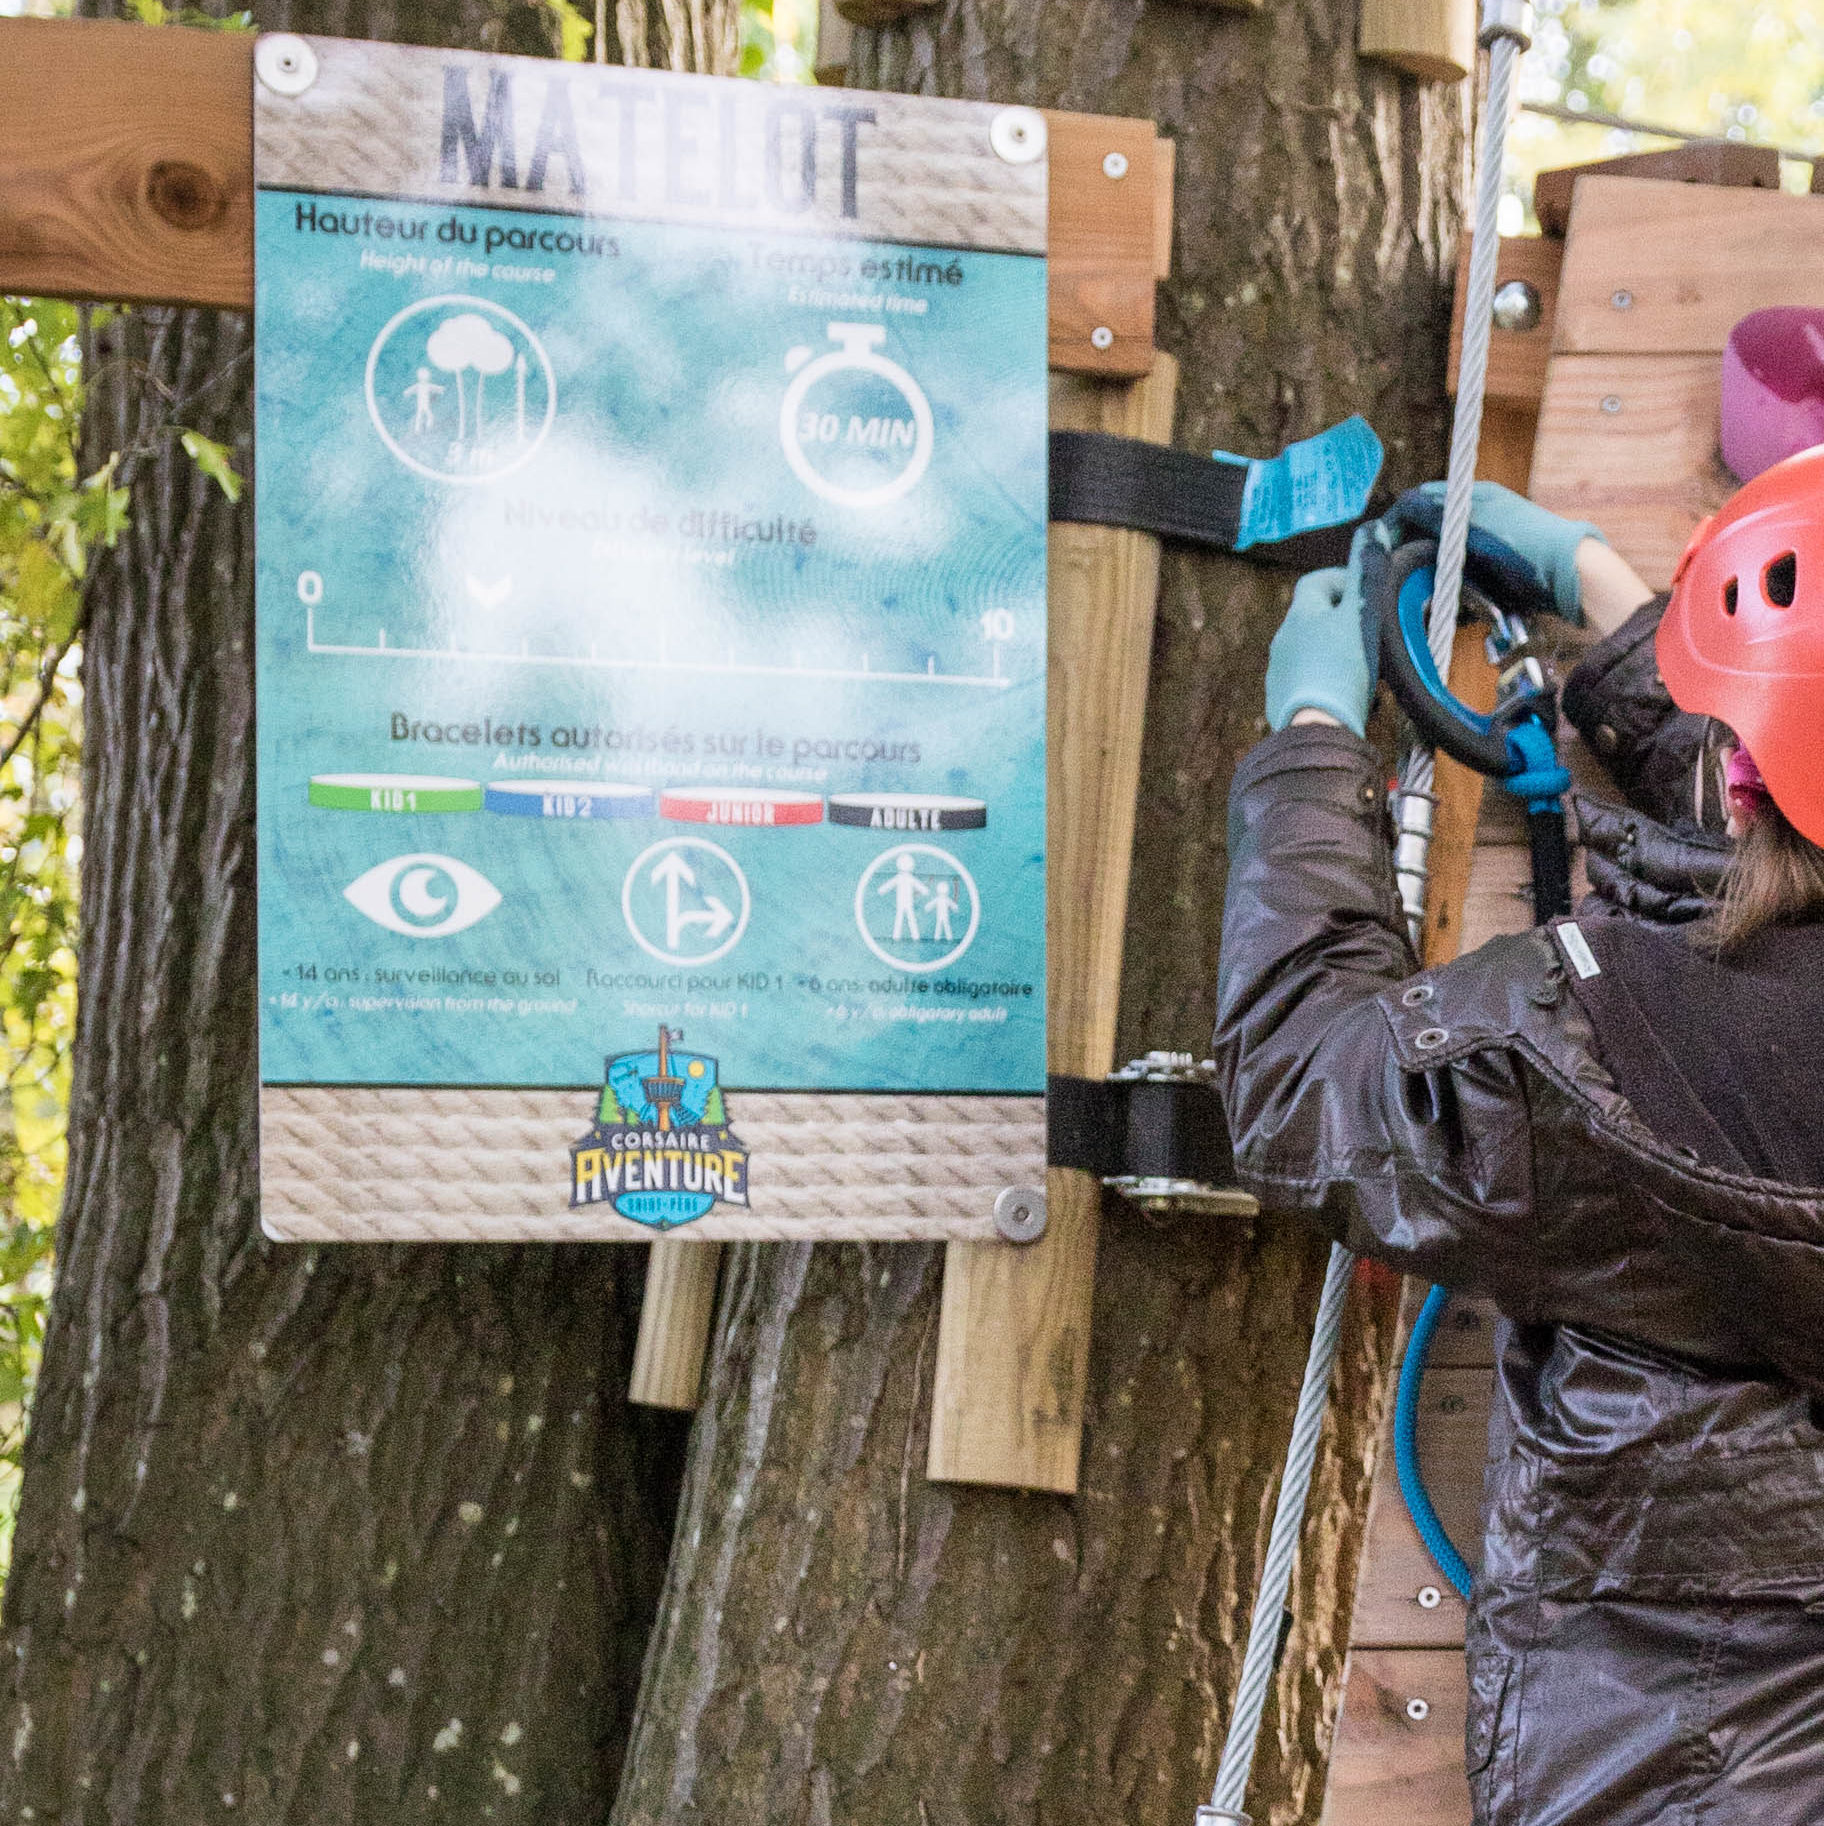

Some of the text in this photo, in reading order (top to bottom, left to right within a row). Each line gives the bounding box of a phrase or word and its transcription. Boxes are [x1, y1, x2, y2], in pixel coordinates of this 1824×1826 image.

[439, 64, 878, 219] MATELOT
[294, 202, 621, 258] Hauteur du parcours
[360, 249, 427, 277] Height
[456, 257, 488, 278] the
[491, 264, 556, 284] course
[859, 255, 964, 286] estimé
[799, 412, 916, 448] 30 MIN
[504, 498, 818, 546] Niveau de difficulté
[297, 570, 323, 606] 0
[980, 607, 1016, 642] 10
[391, 711, 921, 765] Bracelets autorisés sur le parcours
[706, 801, 775, 826] JUNIOR
[870, 807, 941, 830] ADULTE
[375, 966, 497, 987] surveillance
[502, 972, 527, 986] au
[687, 974, 732, 994] pour
[737, 972, 769, 991] KID
[933, 977, 1033, 999] obligatoire
[611, 1131, 711, 1151] CORSAIRE
[576, 1147, 747, 1204] AVENTURE
